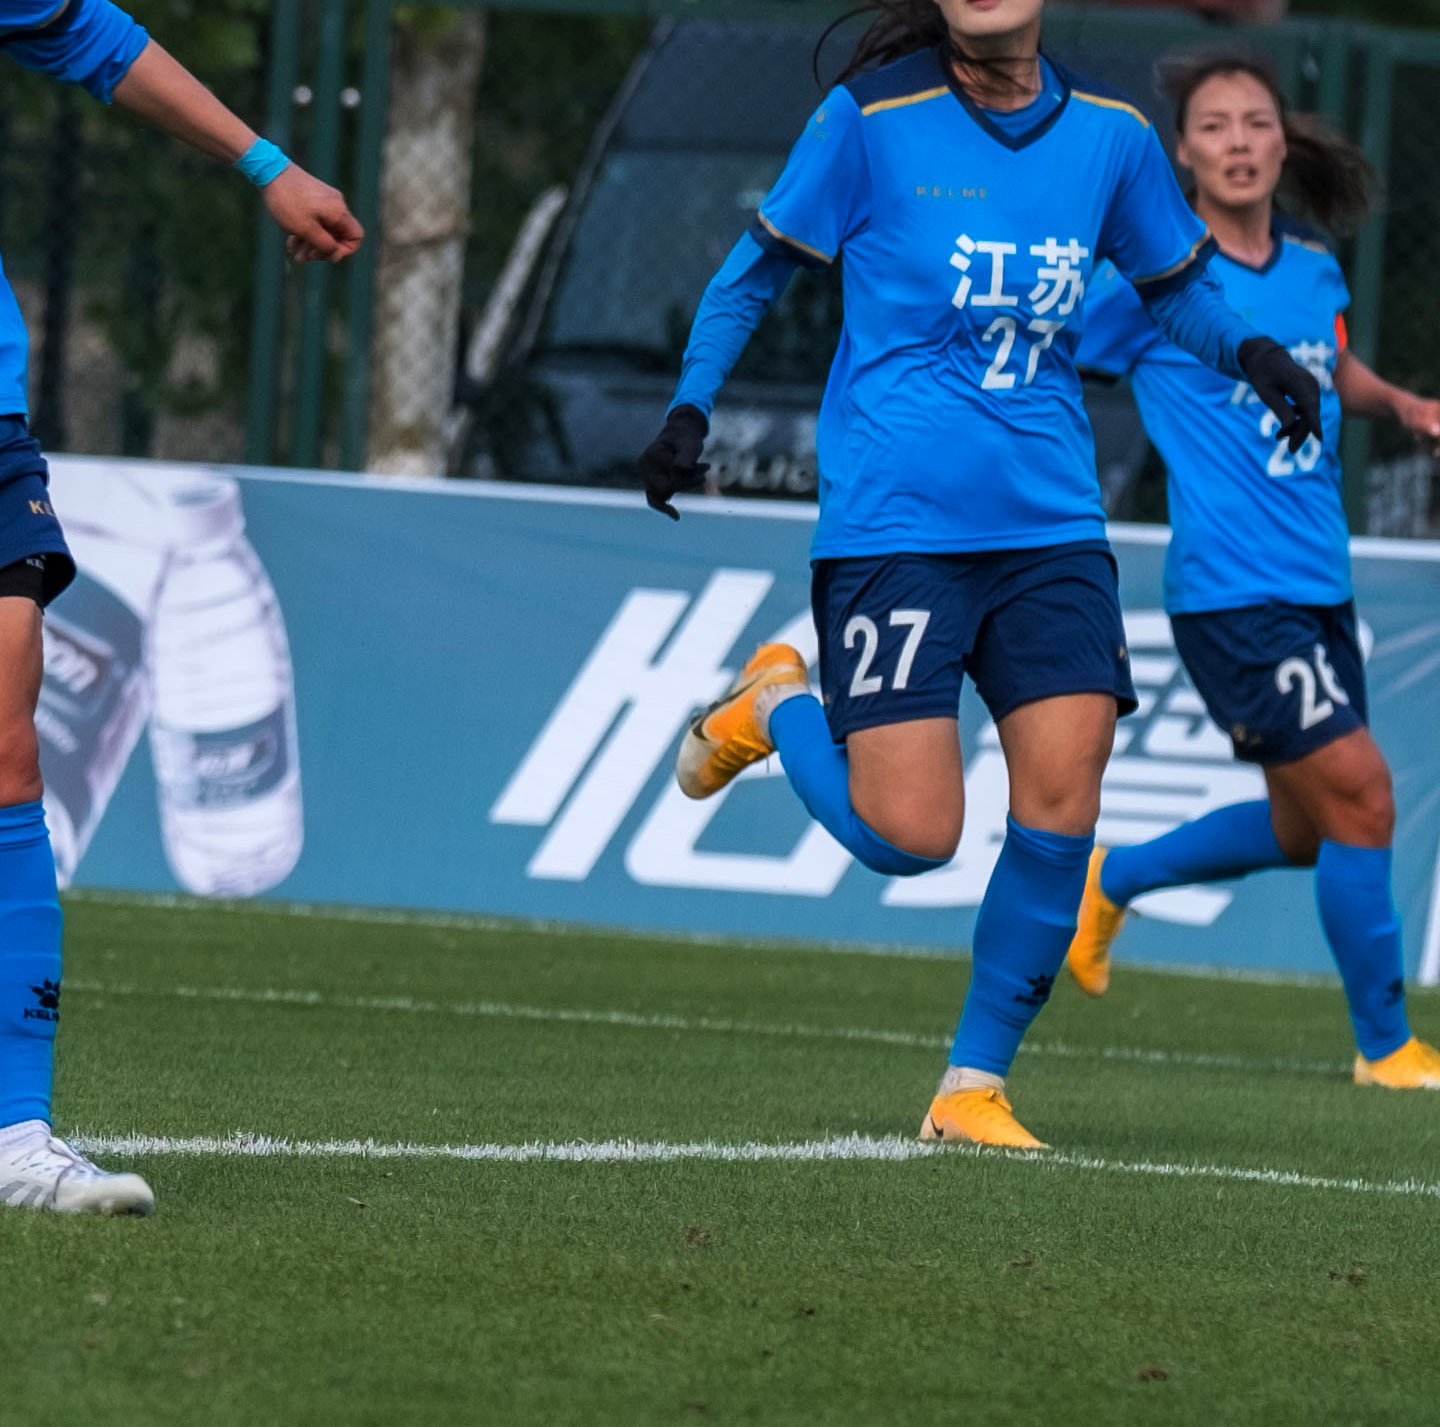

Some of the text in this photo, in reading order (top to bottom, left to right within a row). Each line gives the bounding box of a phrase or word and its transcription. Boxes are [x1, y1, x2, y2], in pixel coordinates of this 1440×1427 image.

[915, 185, 989, 200] KELME
[949, 233, 1089, 316] 江苏
[980, 317, 1067, 390] 27
[843, 607, 932, 699] 27
